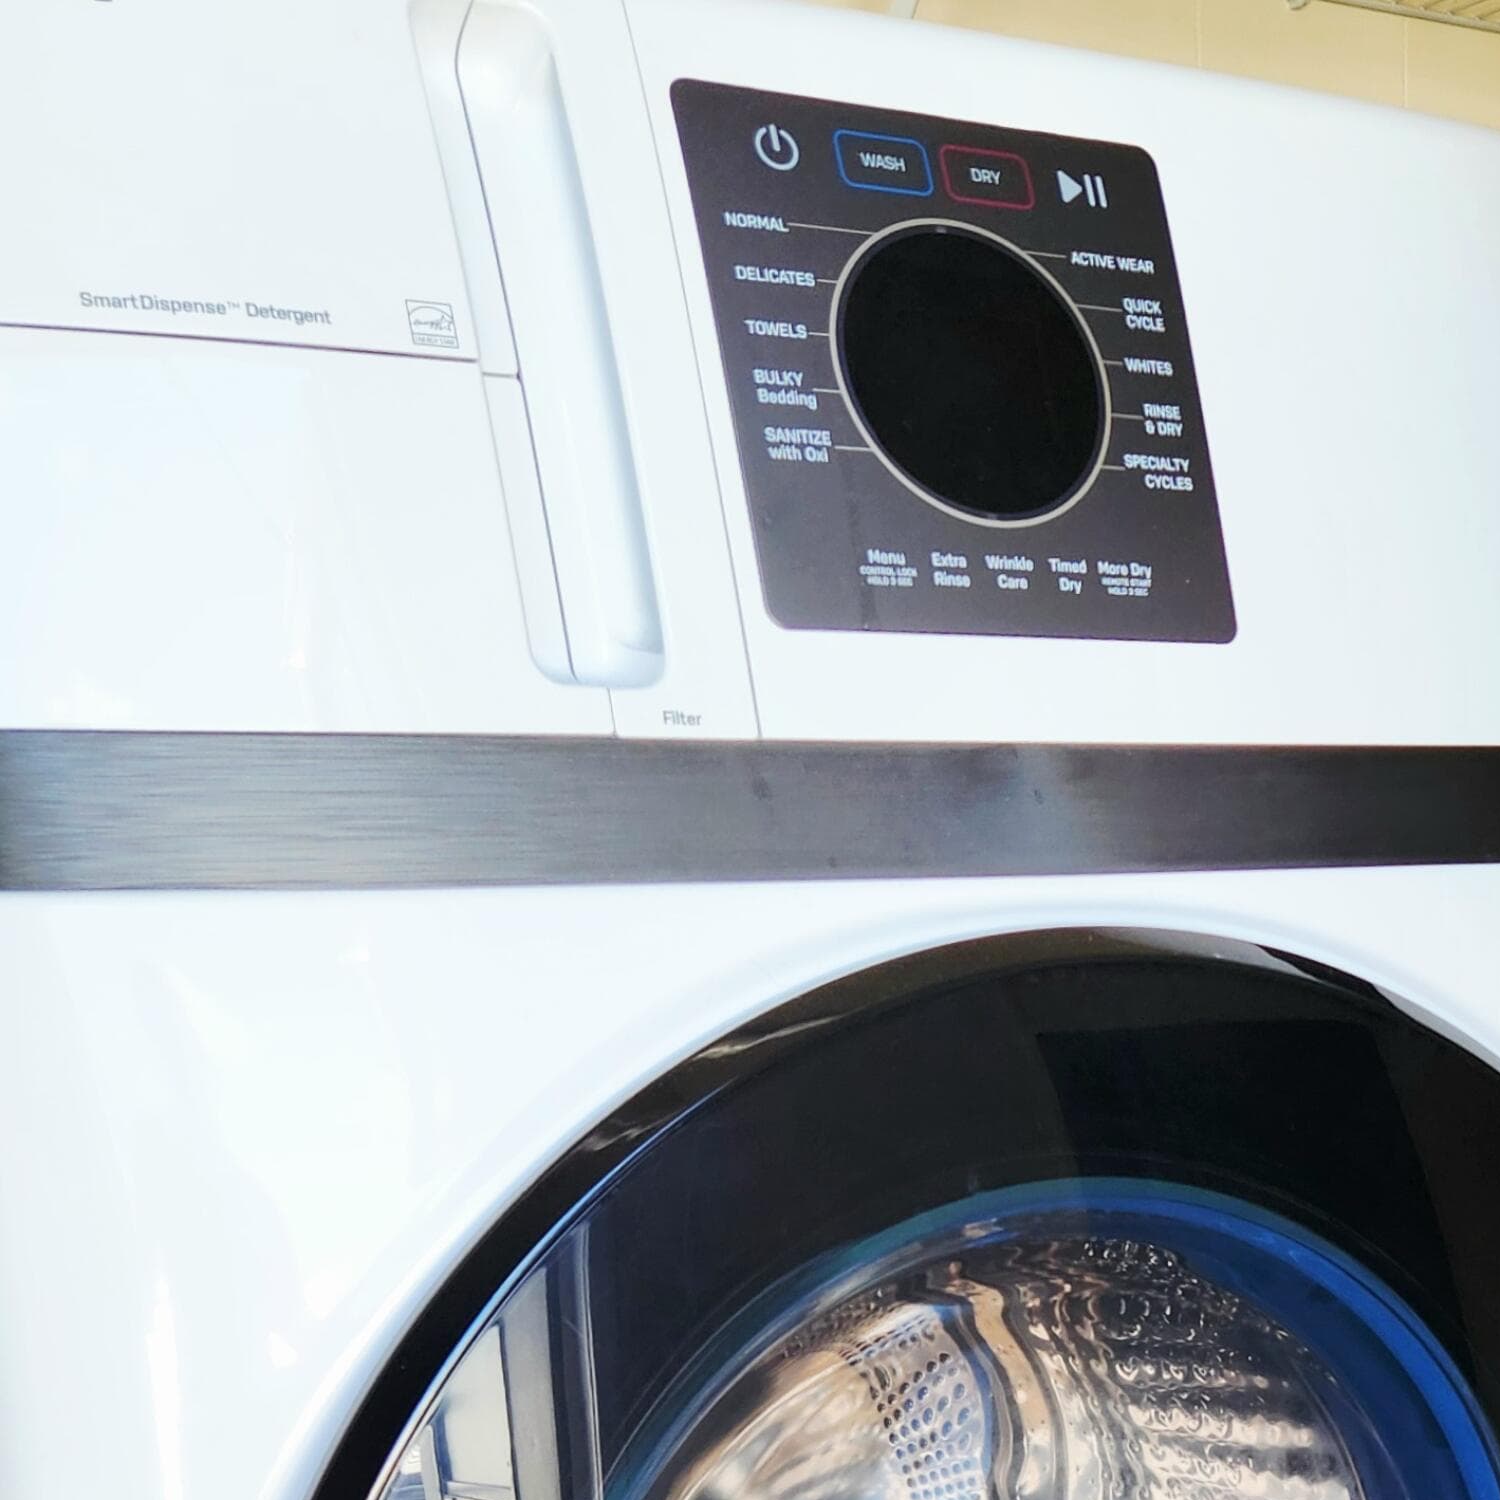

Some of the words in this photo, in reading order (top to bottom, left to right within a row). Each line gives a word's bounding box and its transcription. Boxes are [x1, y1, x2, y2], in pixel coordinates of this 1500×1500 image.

[859, 151, 906, 172] WASH
[970, 167, 1001, 184] DRY
[724, 211, 790, 232] NORMAL
[1071, 251, 1116, 270] ACTIVE
[1117, 256, 1155, 274] WEAR
[734, 265, 816, 287] DELICATES
[244, 302, 333, 325] Detergent
[1123, 297, 1162, 314] QUICK
[744, 320, 808, 339] TOWELS
[1126, 315, 1166, 332] CYCLE
[1123, 357, 1174, 377] WHITES
[753, 368, 803, 387] BULKY
[757, 388, 818, 411] Bedding
[1143, 403, 1182, 421] RINSE
[764, 426, 833, 447] SANITIZE
[1145, 421, 1156, 435] &
[1157, 422, 1184, 437] DRY
[768, 446, 802, 461] with
[804, 447, 829, 463] Oxi
[1123, 454, 1190, 472] SPECIALTY
[1144, 474, 1194, 492] CYCLES
[867, 549, 906, 566] Menu
[930, 552, 968, 568] Extra
[984, 555, 1034, 572] Wrinkle
[1048, 558, 1088, 575] Timed
[1097, 561, 1129, 576] More
[1130, 562, 1152, 579] Dry
[933, 571, 971, 588] Rinse
[997, 573, 1029, 590] Care
[1059, 578, 1082, 595] Dry
[662, 710, 702, 726] Filter
